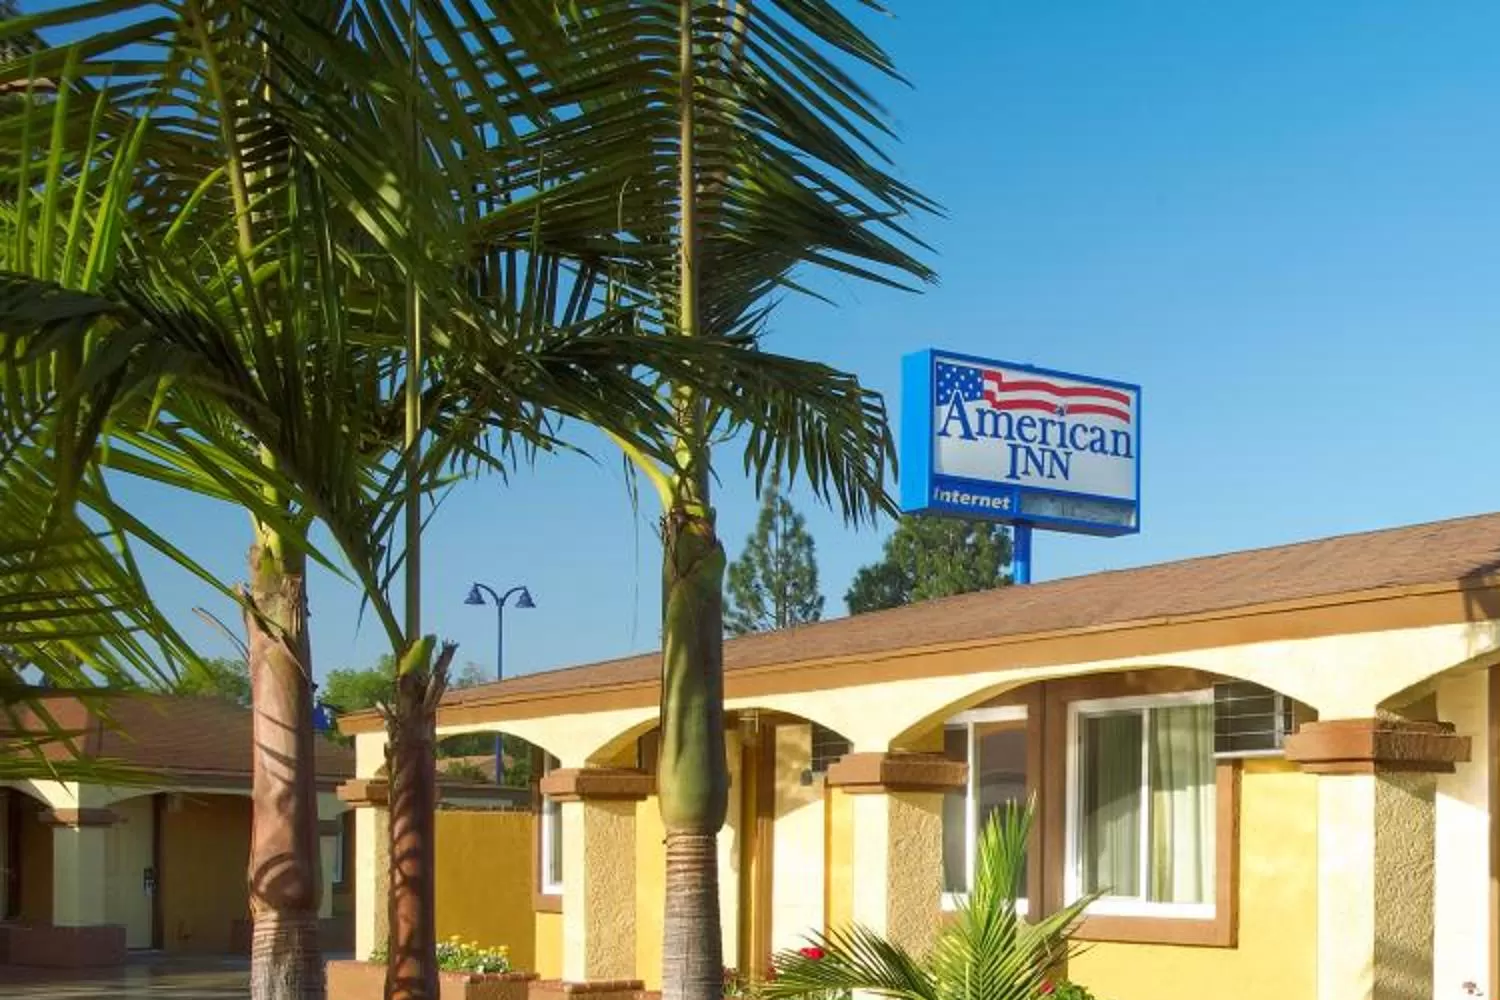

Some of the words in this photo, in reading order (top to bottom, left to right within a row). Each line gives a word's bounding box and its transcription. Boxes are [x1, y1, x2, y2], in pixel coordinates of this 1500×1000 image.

[937, 389, 1134, 459] American
[1005, 442, 1072, 481] INN
[934, 487, 1010, 511] Internet
